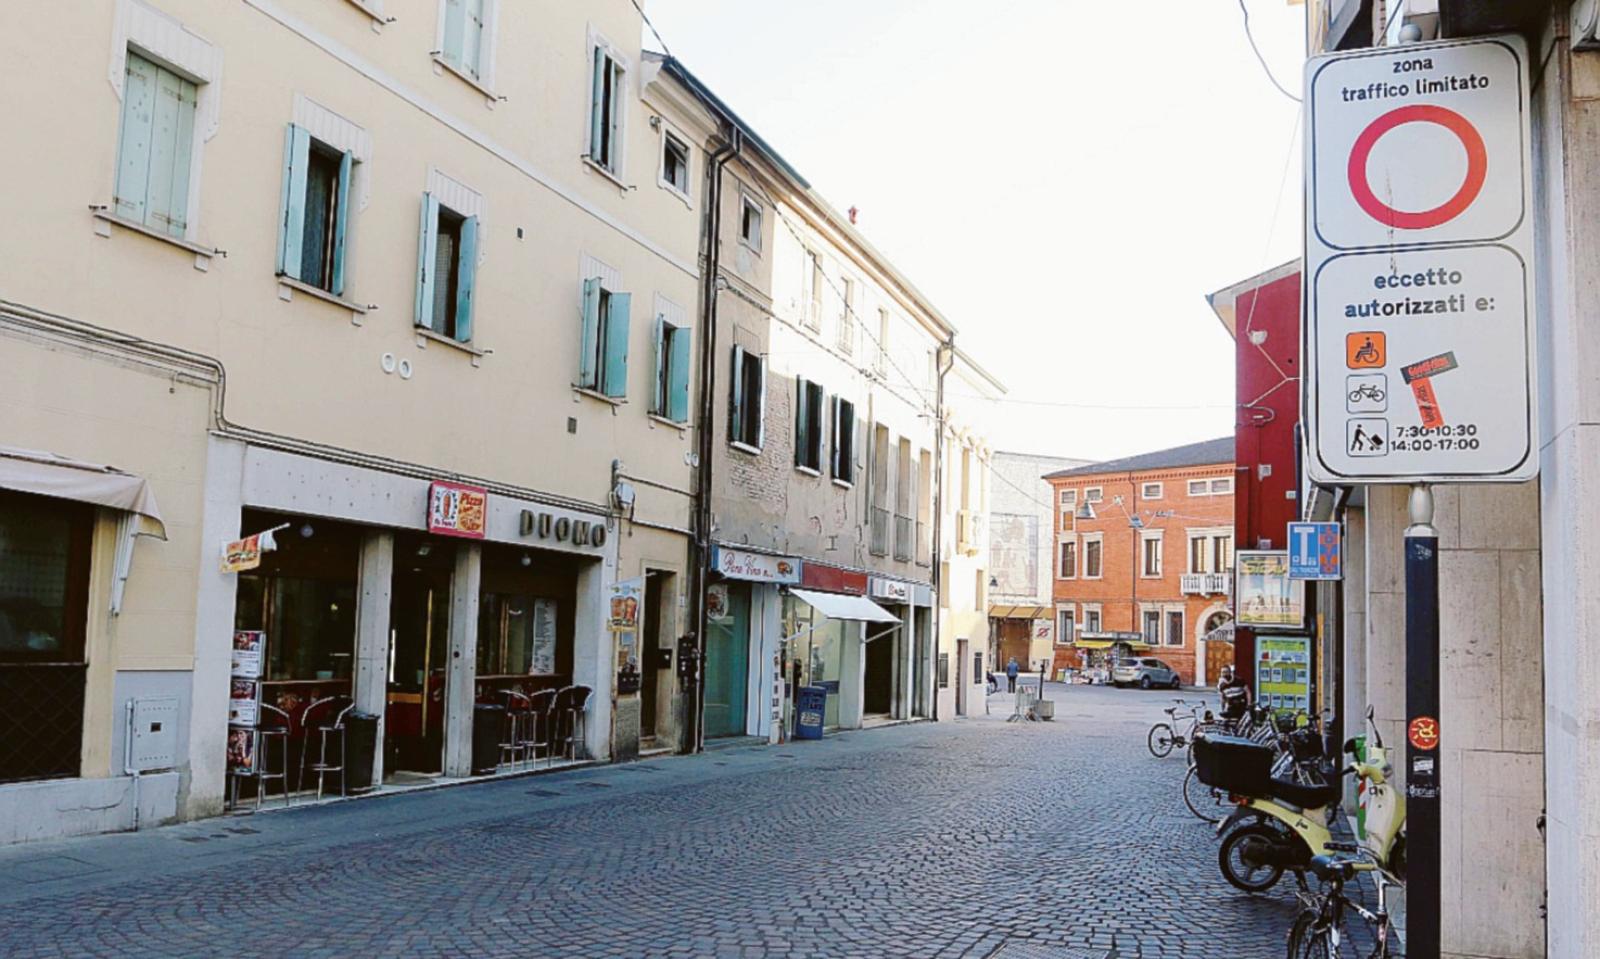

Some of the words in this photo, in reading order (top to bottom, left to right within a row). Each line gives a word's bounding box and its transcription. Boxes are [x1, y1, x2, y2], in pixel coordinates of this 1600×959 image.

[1393, 58, 1433, 73] zona
[1342, 82, 1409, 102] traffico
[1416, 74, 1490, 94] limitato
[1374, 267, 1462, 289] eccetto
[1344, 294, 1465, 318] autorizzati
[1475, 296, 1495, 311] e:
[1396, 424, 1477, 438] 7:30-10:30
[1390, 438, 1479, 452] 14:00-17:00
[519, 509, 606, 548] DUOMO
